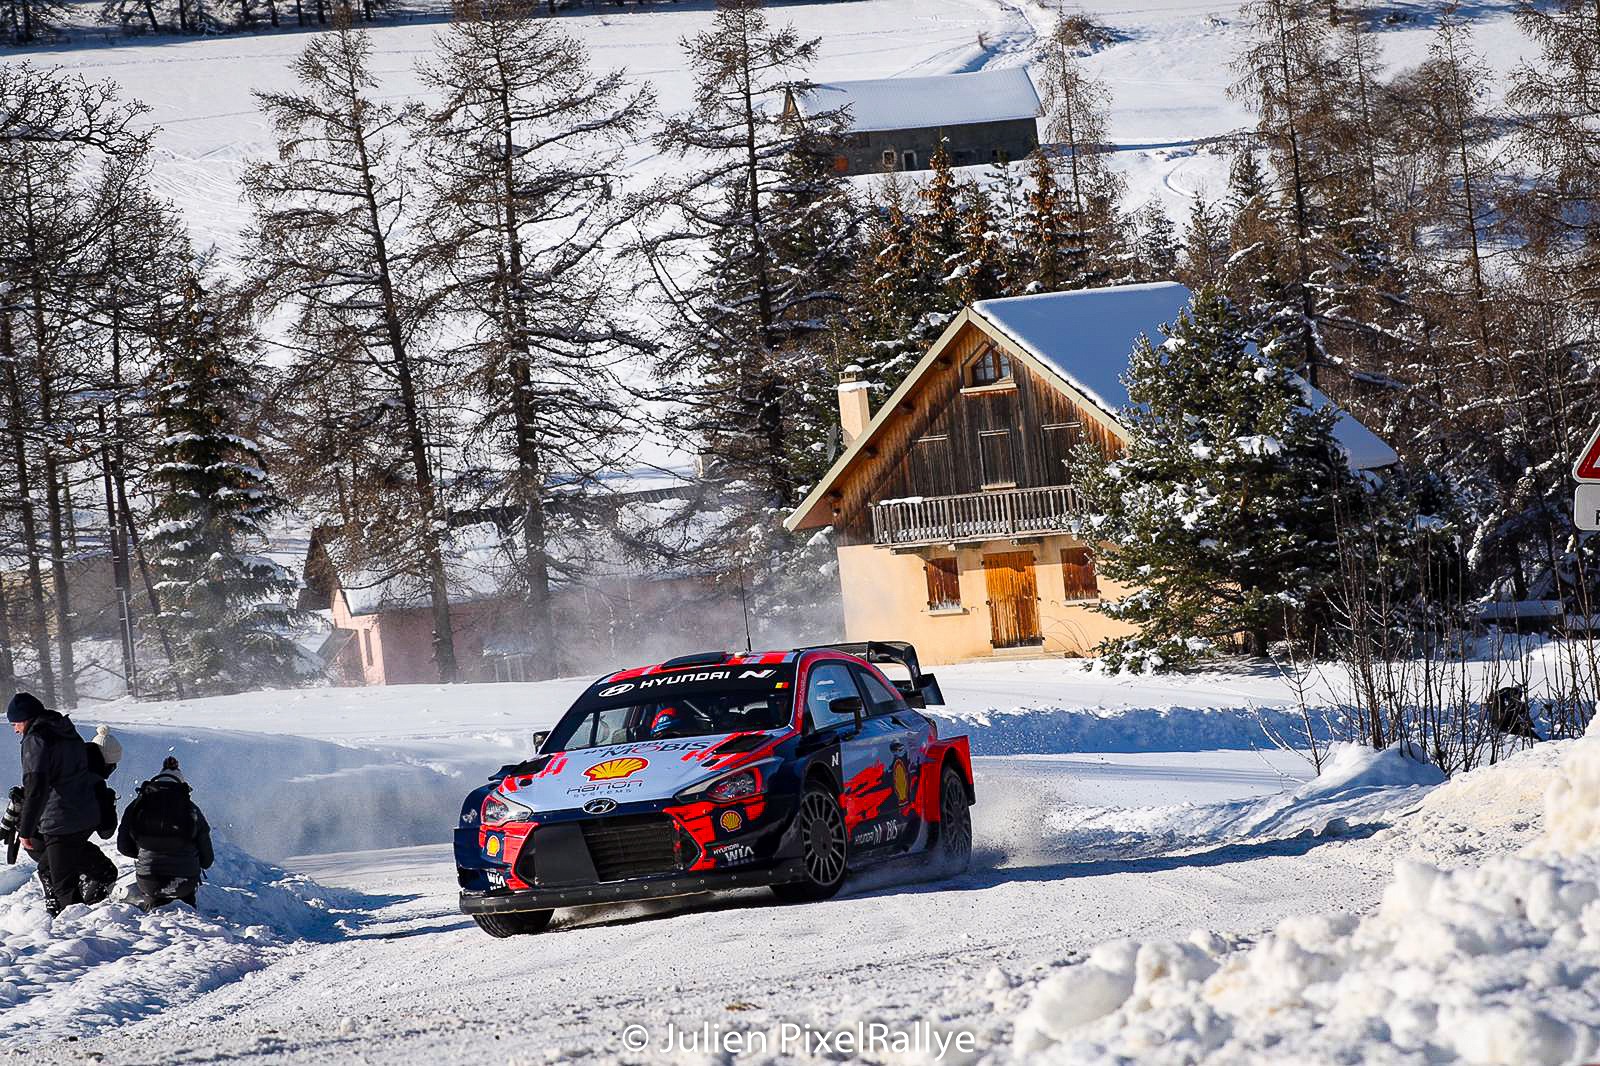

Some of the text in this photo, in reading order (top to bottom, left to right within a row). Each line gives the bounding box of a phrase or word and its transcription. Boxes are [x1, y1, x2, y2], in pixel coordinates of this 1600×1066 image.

[639, 671, 730, 689] HYUNDAI
[601, 741, 710, 757] MOBIS
[831, 752, 839, 767] N
[713, 843, 740, 856] HYUNDAI
